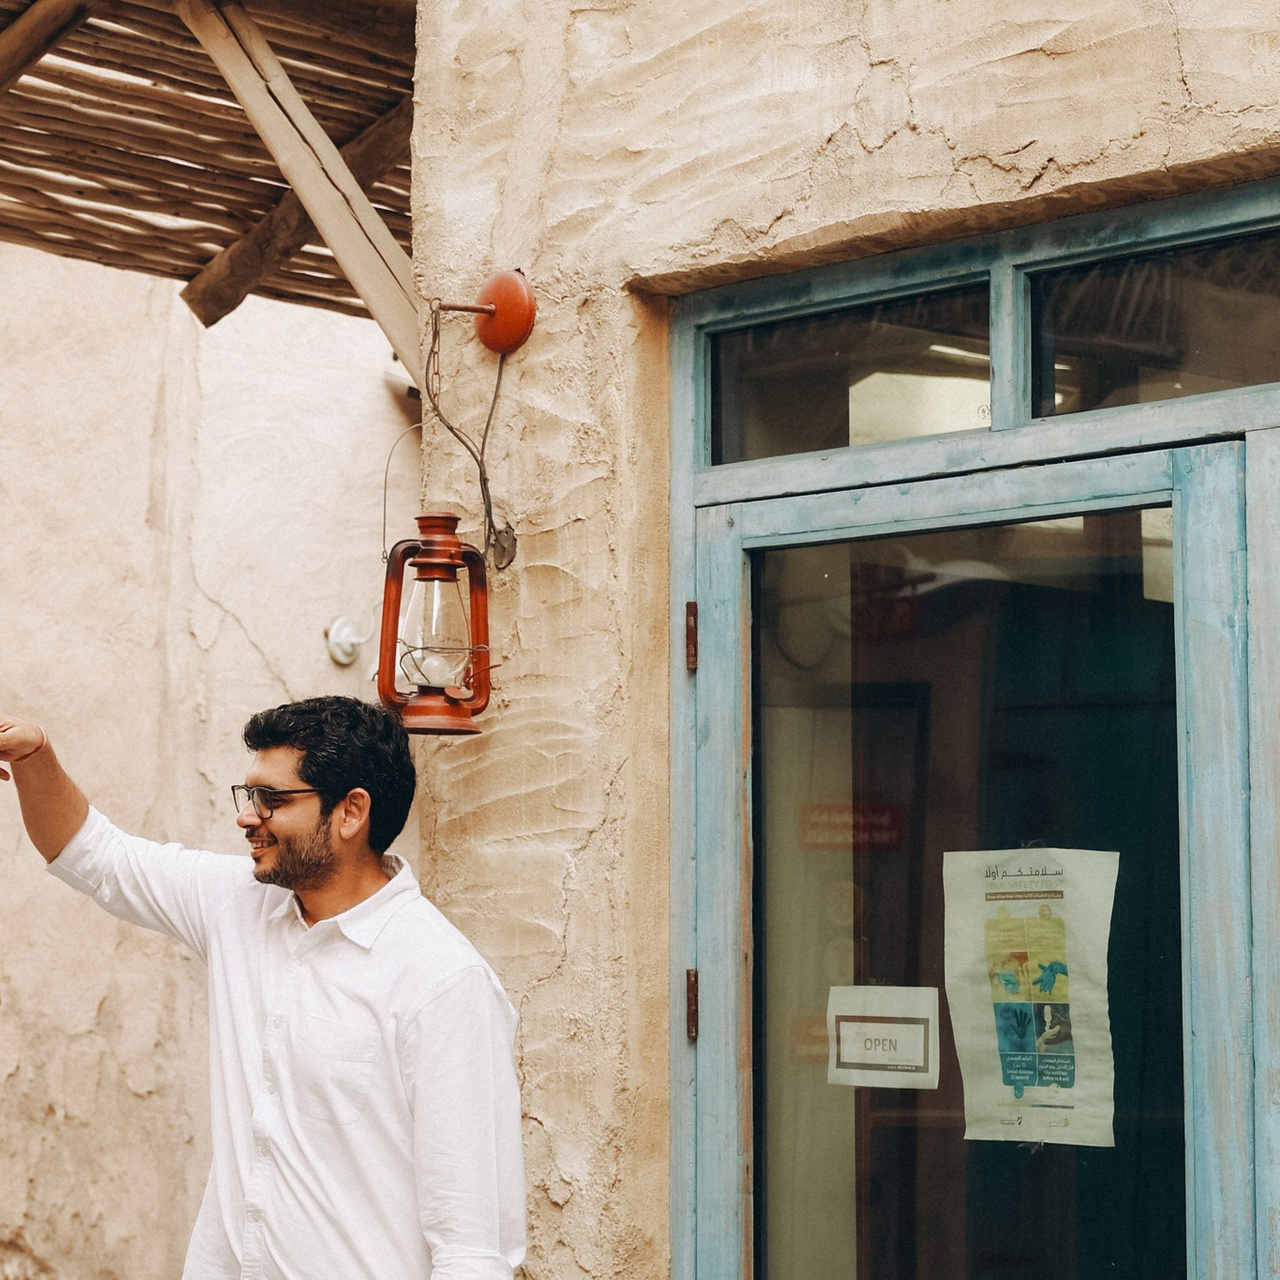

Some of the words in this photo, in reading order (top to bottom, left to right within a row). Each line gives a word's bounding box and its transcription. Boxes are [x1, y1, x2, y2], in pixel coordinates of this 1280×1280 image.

[1008, 880, 1039, 890] SAFETY
[1041, 879, 1064, 889] FIRST
[864, 1037, 898, 1052] OPEN
